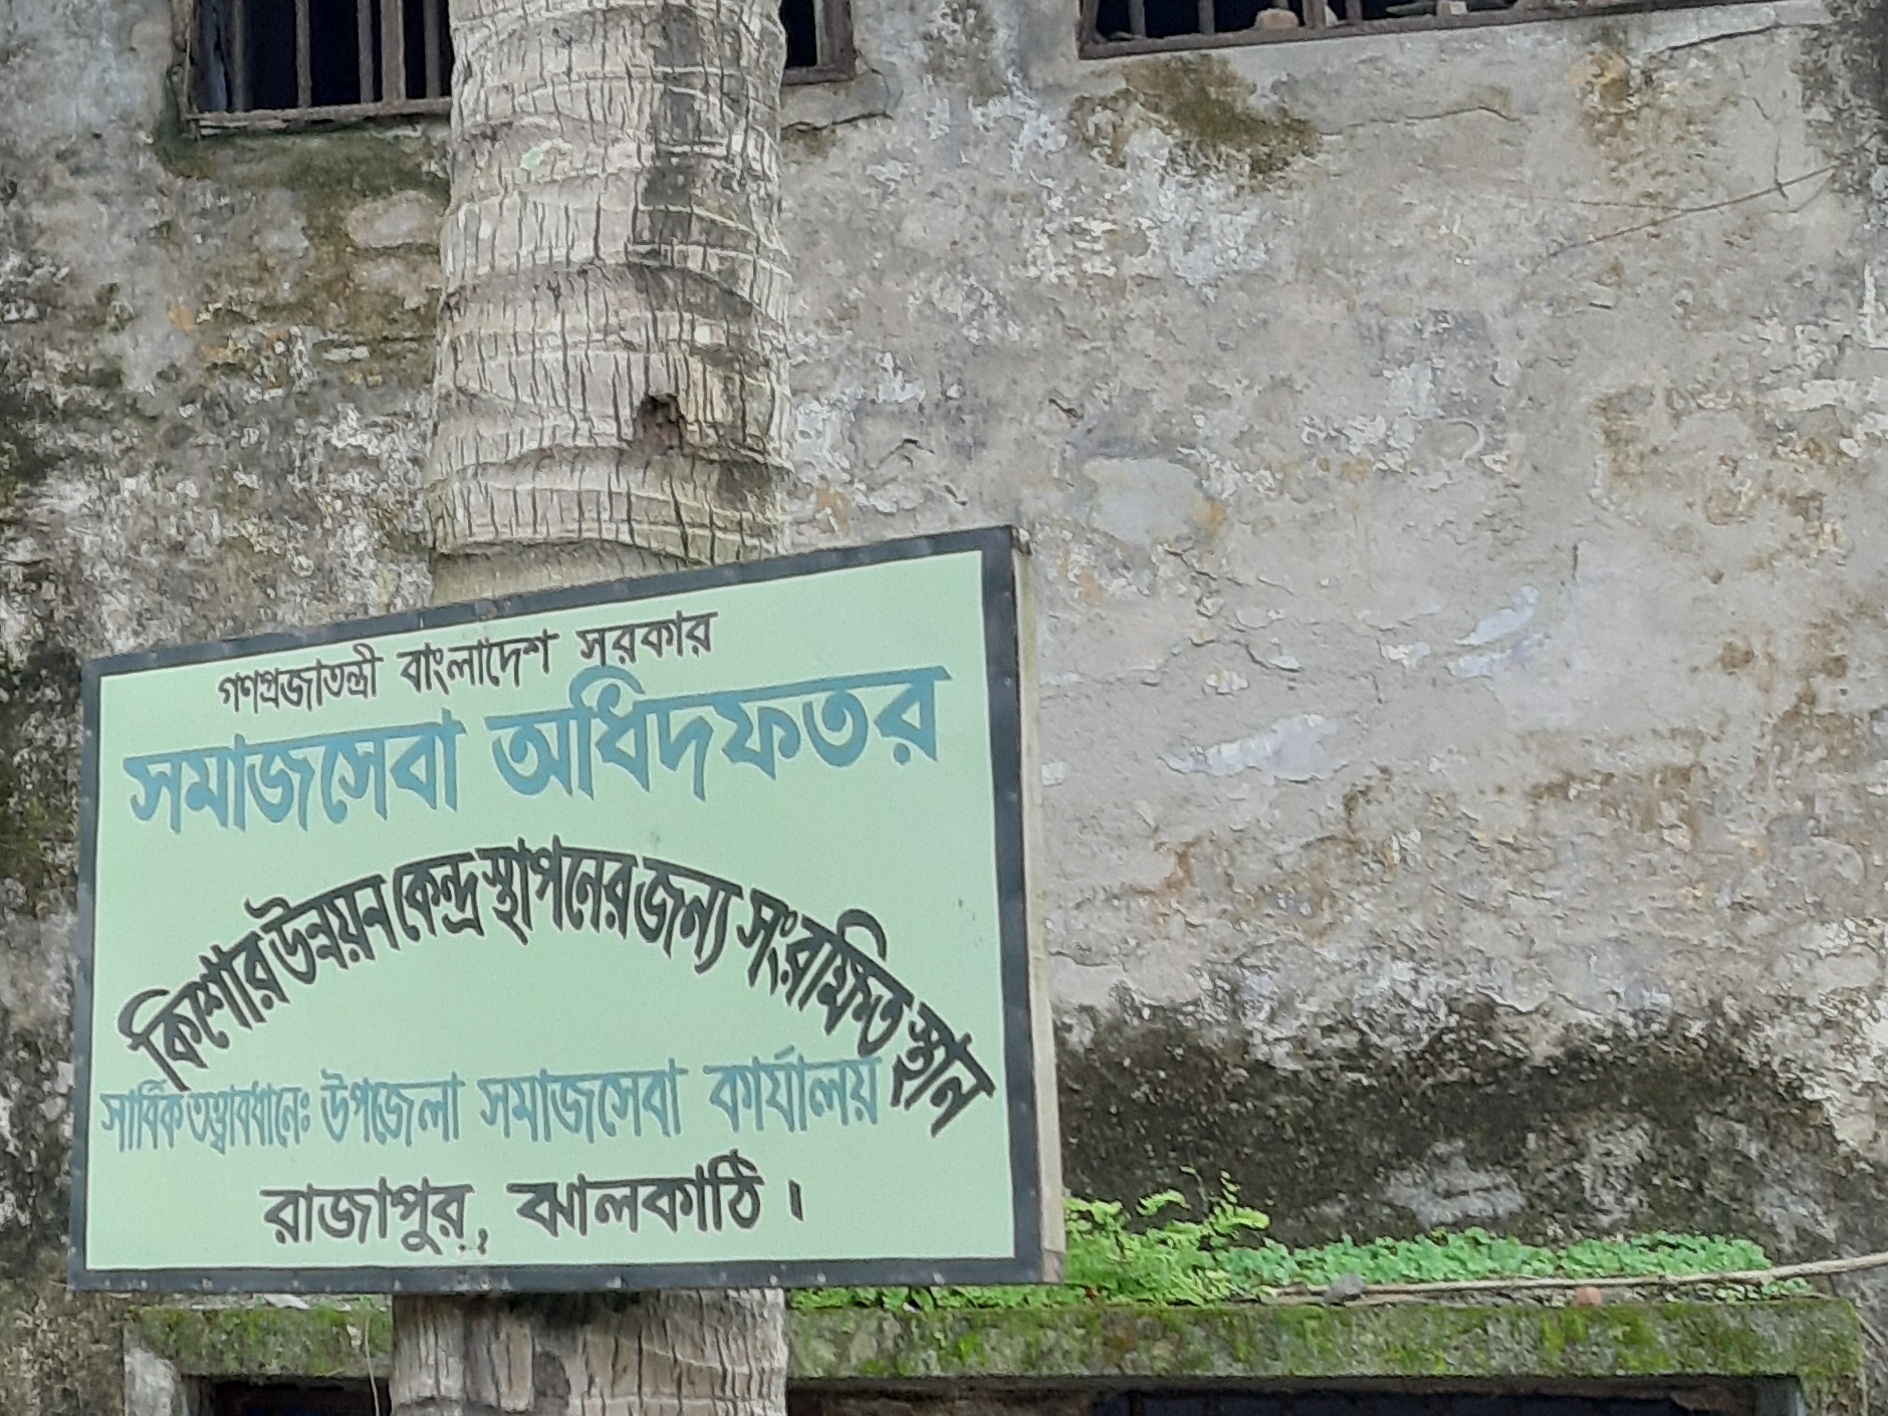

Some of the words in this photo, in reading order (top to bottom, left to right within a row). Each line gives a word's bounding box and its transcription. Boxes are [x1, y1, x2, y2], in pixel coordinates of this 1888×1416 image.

[218, 643, 384, 713] গণপ্রজাতন্ত্রী
[397, 628, 559, 694] বাংলাদেশ
[577, 610, 719, 668] সরকার
[125, 709, 466, 834] সমাজসেবা
[485, 665, 951, 801] অধিদফতর
[118, 933, 290, 1092] কিশোর
[244, 873, 400, 985] উন্নয়ন
[393, 852, 486, 942] কেন্দ্র
[474, 834, 639, 946] স্থাপনের
[635, 856, 743, 975] জন্য
[737, 887, 915, 1057] সংরক্ষিত
[890, 1001, 996, 1137] স্থান
[320, 1068, 466, 1146] উপজেলা
[477, 1057, 689, 1144] সমাজসেবা
[703, 1045, 882, 1134] কার্যালয়
[506, 1149, 765, 1239] ঝালকাঠি
